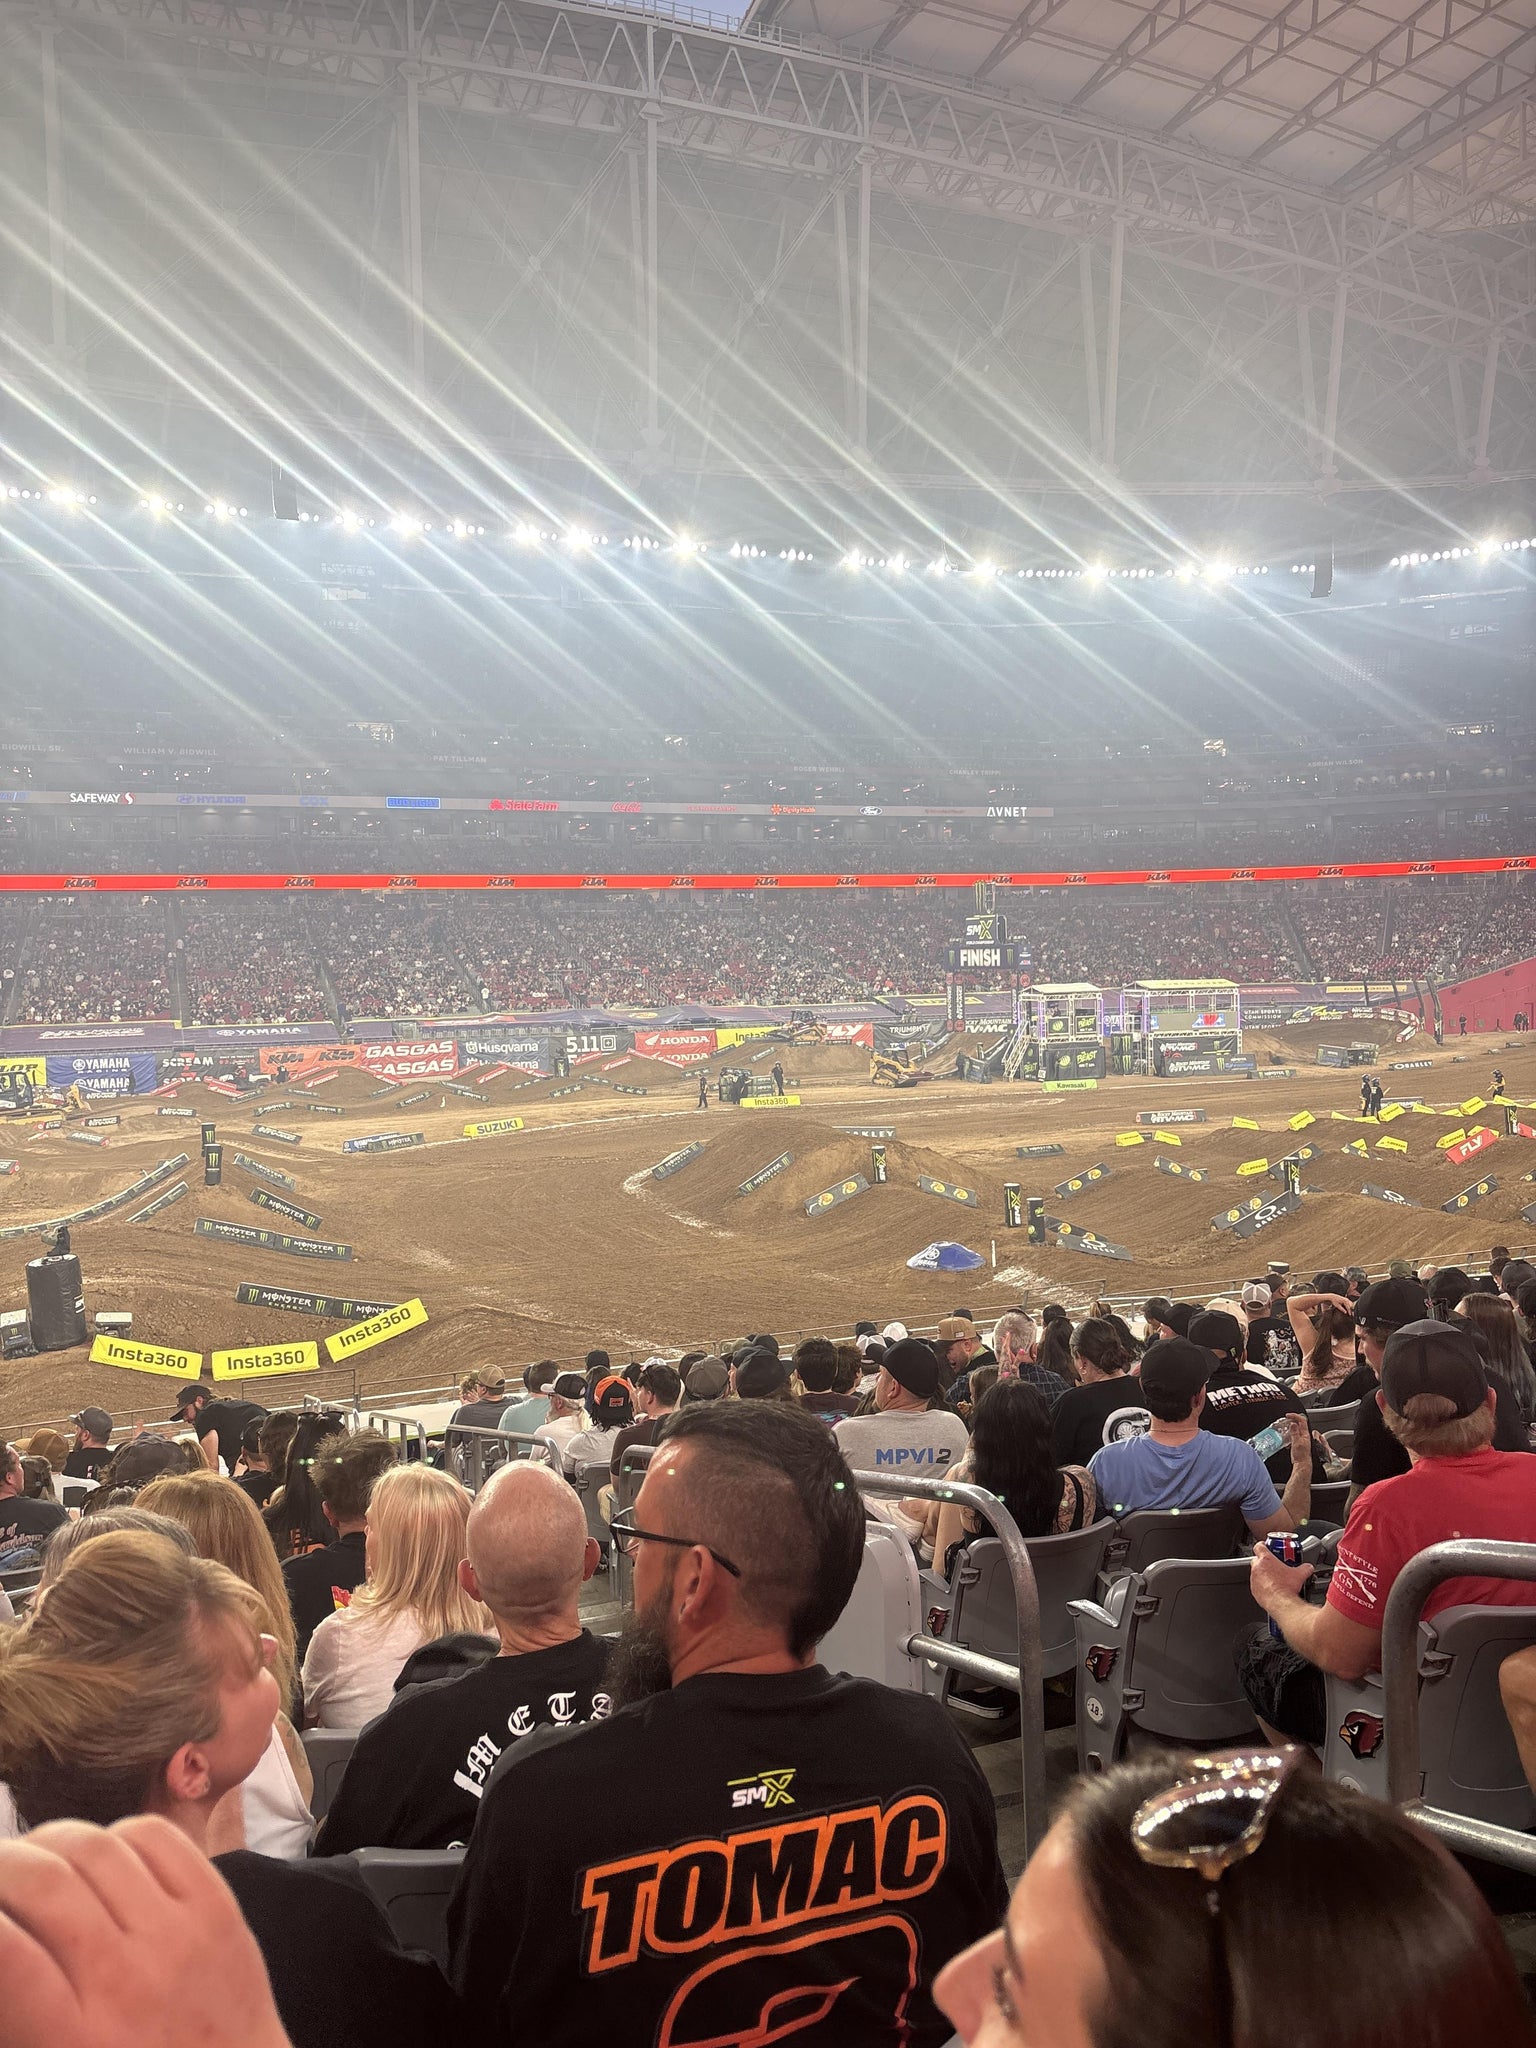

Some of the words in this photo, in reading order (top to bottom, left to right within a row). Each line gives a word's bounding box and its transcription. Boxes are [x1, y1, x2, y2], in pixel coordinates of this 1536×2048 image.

[70, 792, 121, 803] SAFEWAY
[987, 807, 1027, 817] AVNET
[1408, 863, 1436, 874] KTM
[1503, 859, 1531, 869] KTM
[1145, 872, 1171, 882] KTM
[1231, 870, 1256, 880] KTM
[1317, 867, 1343, 877] KTM
[64, 876, 97, 888] KTM
[176, 876, 208, 888] KTM
[284, 876, 315, 887] KTM
[387, 875, 417, 887] KTM
[487, 875, 515, 887] KTM
[580, 875, 607, 886] KTM
[669, 875, 696, 886] KTM
[754, 875, 779, 886] KTM
[836, 875, 860, 886] KTM
[914, 875, 937, 886] KTM
[991, 874, 1013, 885] KTM
[1064, 874, 1087, 884] KTM
[960, 949, 1000, 967] FINISH
[236, 1027, 302, 1036] YAMAHA
[566, 1035, 599, 1052] 5.11
[660, 1035, 710, 1044] HONDA
[365, 1041, 453, 1058] GASGAS
[478, 1041, 539, 1055] Husqvarna
[318, 1048, 355, 1061] KTM
[86, 1058, 131, 1069] YAMAHA
[162, 1057, 213, 1067] SCREAM
[87, 1077, 130, 1089] YAMAHA
[754, 1098, 788, 1106] Insta360
[476, 1120, 520, 1135] SUZUKI
[1459, 1135, 1483, 1157] FLY
[753, 1163, 782, 1184] MONSTER
[268, 1199, 305, 1220] MONSTER
[1255, 1206, 1287, 1228] OAKLEY
[216, 1224, 257, 1237] MONSTER
[293, 1240, 334, 1252] MONSTER
[262, 1291, 311, 1306] MONSTER
[339, 1308, 411, 1348] Insta360
[108, 1343, 188, 1369] Insta360
[227, 1350, 305, 1370] Insta360
[1206, 1382, 1281, 1401] METHOD
[1212, 1395, 1243, 1407] RACE
[1353, 1554, 1379, 1574] STYLE
[1338, 1572, 1353, 1589] GS
[1360, 1574, 1377, 1588] 1776
[1346, 1591, 1374, 1609] DEFEND
[1090, 1703, 1100, 1716] 18
[731, 1773, 796, 1809] SMX
[581, 1794, 947, 1974] TOMAC
